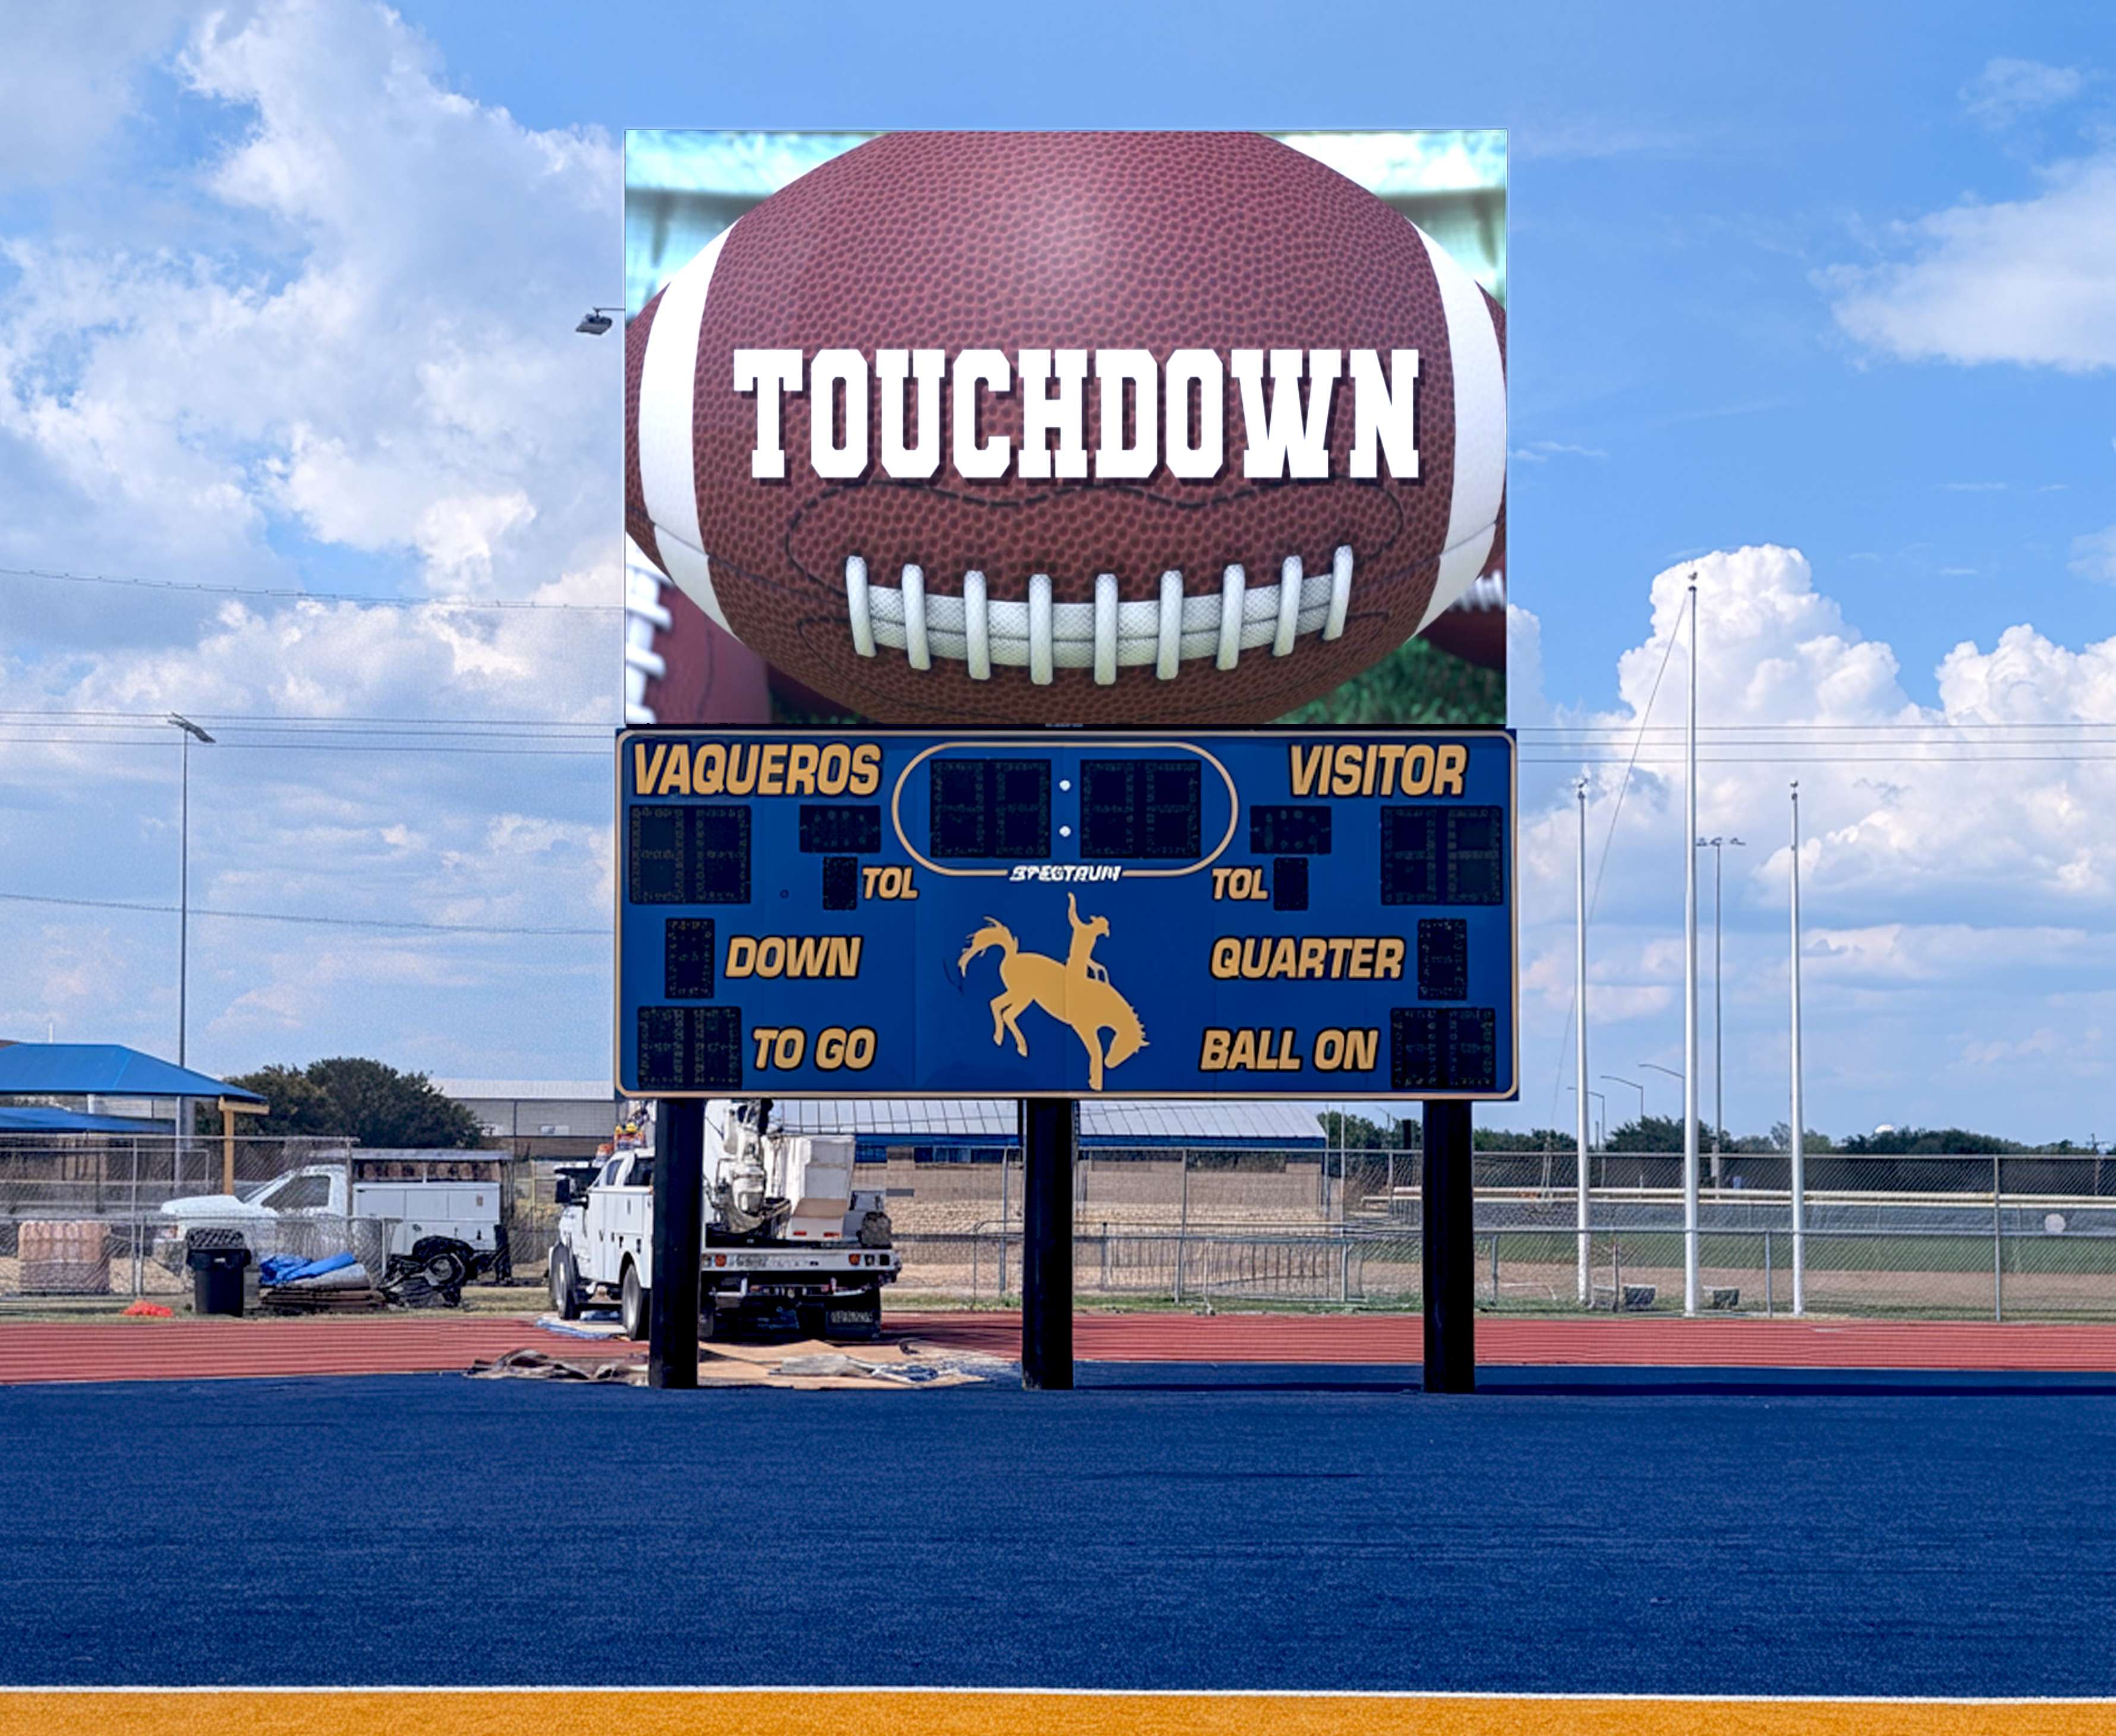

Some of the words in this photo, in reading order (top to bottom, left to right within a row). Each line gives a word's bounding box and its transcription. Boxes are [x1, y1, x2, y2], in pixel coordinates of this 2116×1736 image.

[733, 349, 1419, 478] TOUCHDOWN
[634, 743, 881, 795] VAQUEROS
[1291, 745, 1467, 796] VISITOR
[862, 867, 918, 899] TOL
[1009, 865, 1122, 881] SPECTRUM
[1212, 868, 1268, 900] TOL
[725, 937, 861, 978] DOWN
[1211, 938, 1405, 978] QUARTER
[753, 1029, 805, 1069] TO
[815, 1028, 876, 1069] GO
[1201, 1029, 1301, 1070] BALL
[1314, 1029, 1378, 1070] ON
